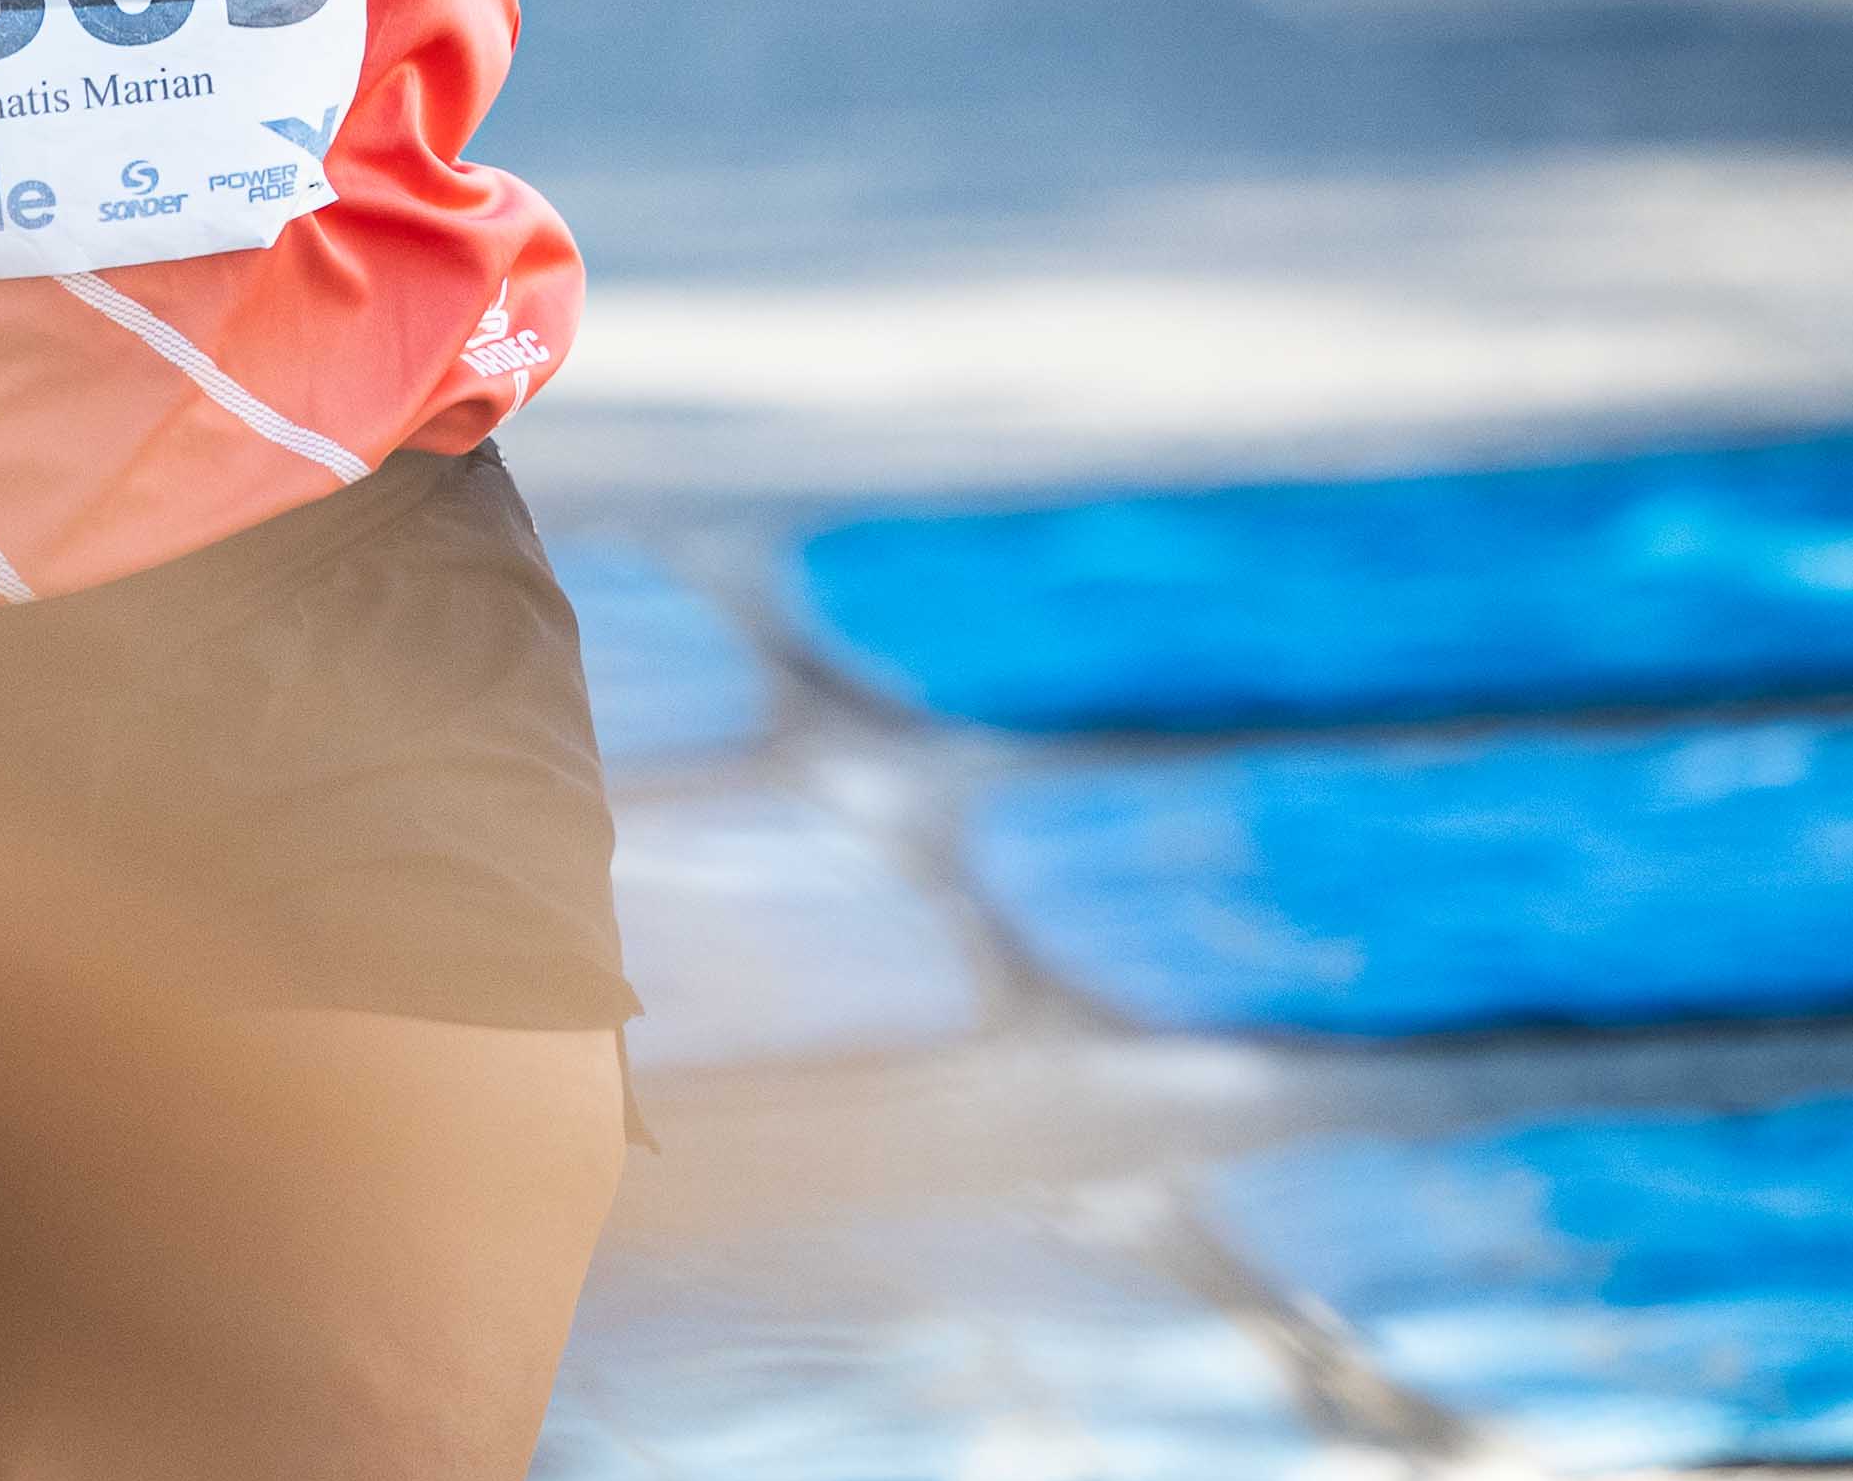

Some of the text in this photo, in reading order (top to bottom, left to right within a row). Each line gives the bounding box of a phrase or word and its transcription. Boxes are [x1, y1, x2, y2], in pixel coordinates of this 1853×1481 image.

[81, 67, 216, 110] Marian
[208, 163, 299, 191] POWER
[248, 181, 296, 204] ADE
